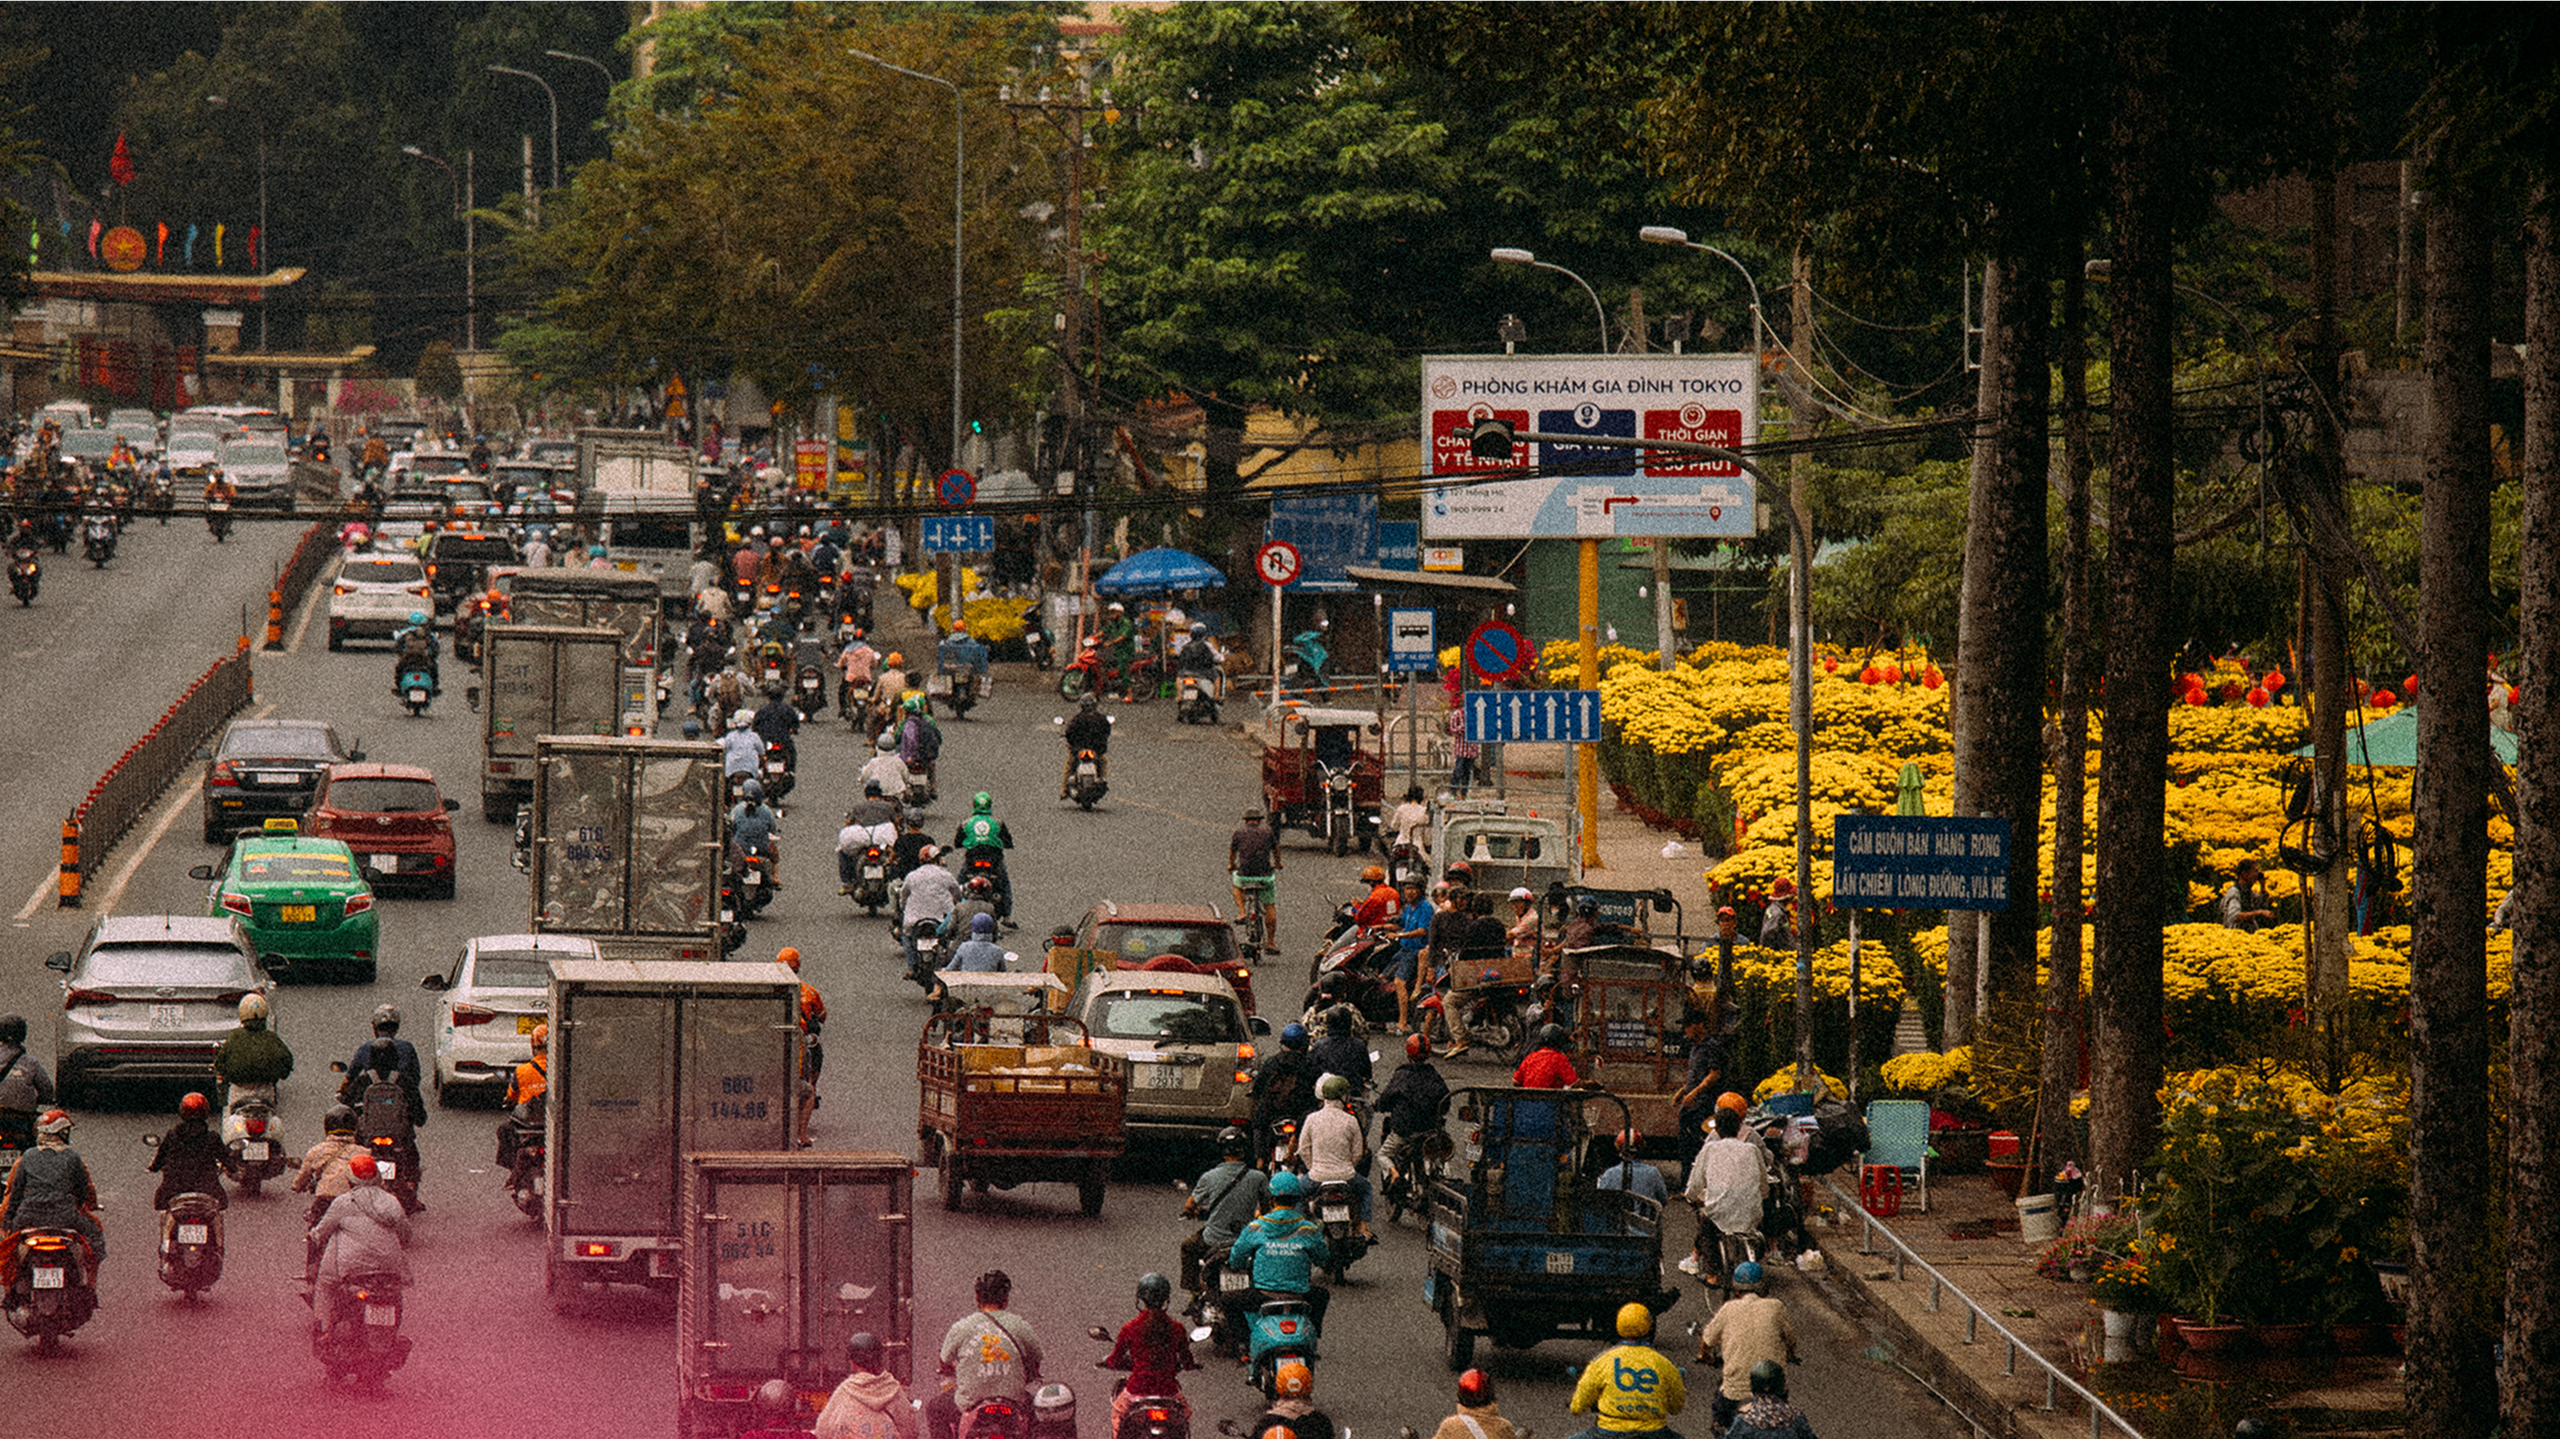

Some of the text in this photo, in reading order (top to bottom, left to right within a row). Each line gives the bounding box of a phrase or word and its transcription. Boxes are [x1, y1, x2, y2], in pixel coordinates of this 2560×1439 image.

[1462, 376, 1743, 395] PHÒNG KHÁM GIA ĐÌNH TOKYO
[1658, 427, 1728, 441] THỜI GIAN
[1438, 452, 1450, 466] Y
[1850, 824, 1873, 855] CẤM
[1907, 826, 1929, 856] BÁN
[1935, 826, 1966, 857] HÀNG
[1971, 834, 2001, 858] RONG
[1858, 865, 1894, 897] CHIẾM
[1897, 866, 1927, 898] LÒNG
[1991, 868, 2007, 900] HÈ
[1614, 1357, 1660, 1395] be
